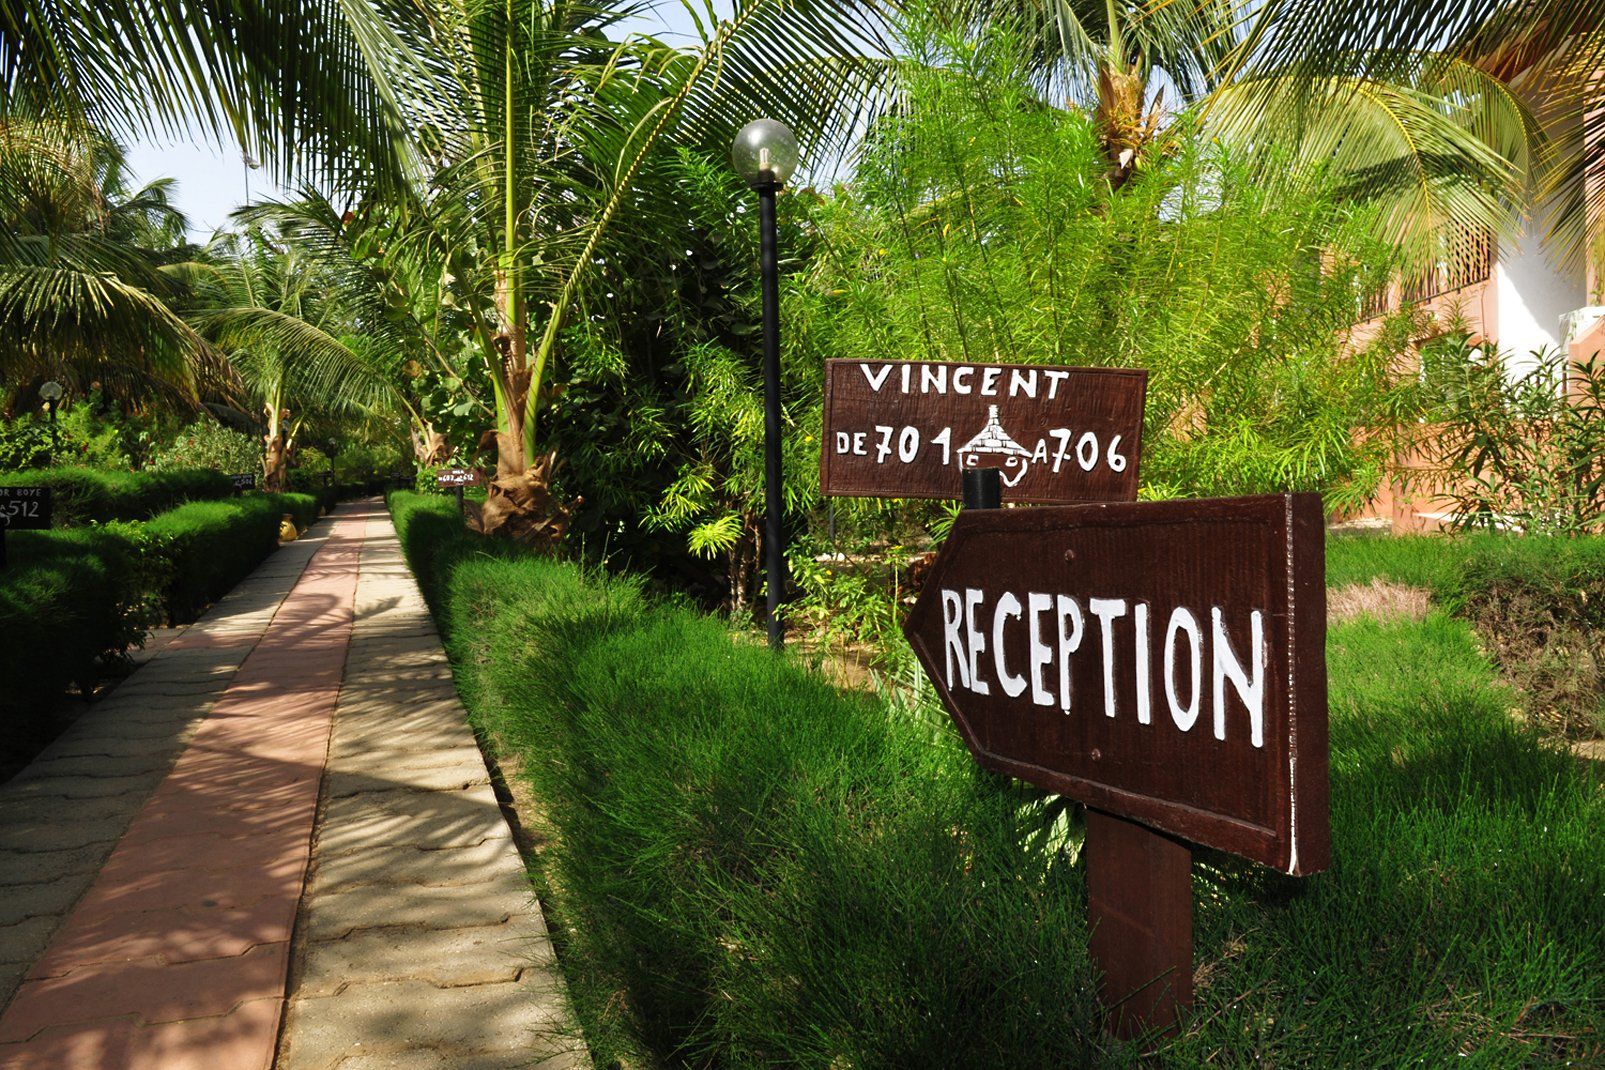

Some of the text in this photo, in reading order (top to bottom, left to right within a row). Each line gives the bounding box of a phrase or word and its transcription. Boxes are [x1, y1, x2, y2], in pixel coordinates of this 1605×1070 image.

[860, 363, 1069, 399] VINCENT
[836, 431, 868, 455] DE
[875, 425, 951, 465] 701
[16, 488, 41, 496] BOYE
[941, 588, 1265, 749] RECEPTION
